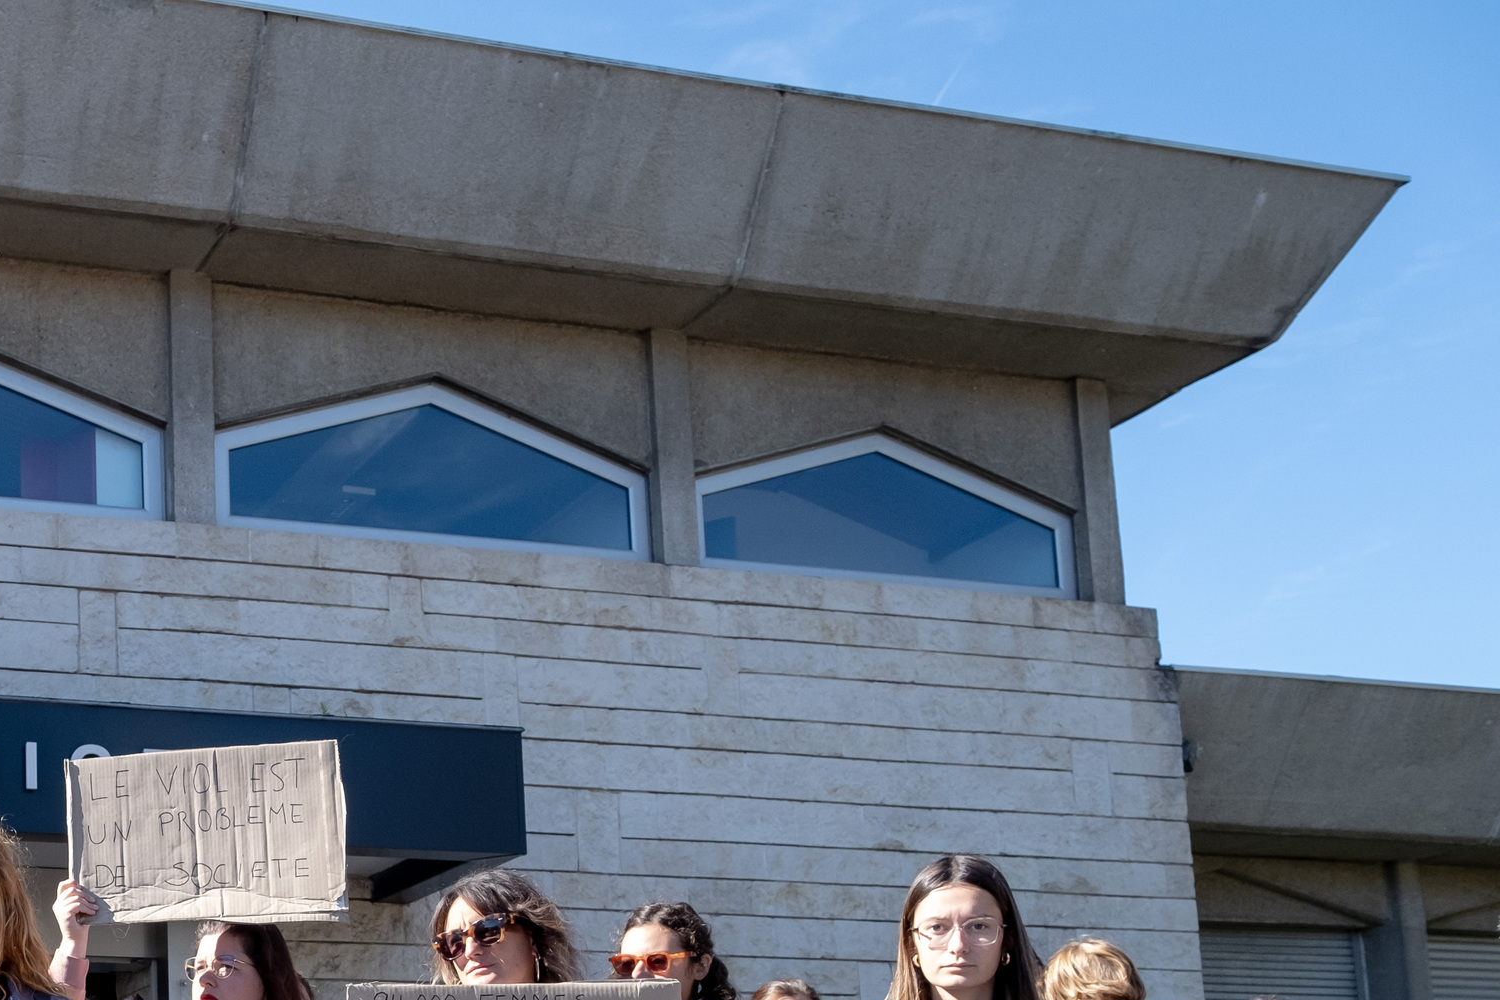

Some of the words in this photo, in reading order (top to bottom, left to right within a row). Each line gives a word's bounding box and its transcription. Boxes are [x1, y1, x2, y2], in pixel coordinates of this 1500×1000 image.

[89, 769, 130, 801] LE
[155, 762, 228, 796] VIOL
[250, 757, 306, 793] EST
[87, 819, 132, 845] UN
[158, 803, 304, 836] PROBLEME
[94, 863, 126, 889] DE
[164, 857, 310, 889] SOCIETE
